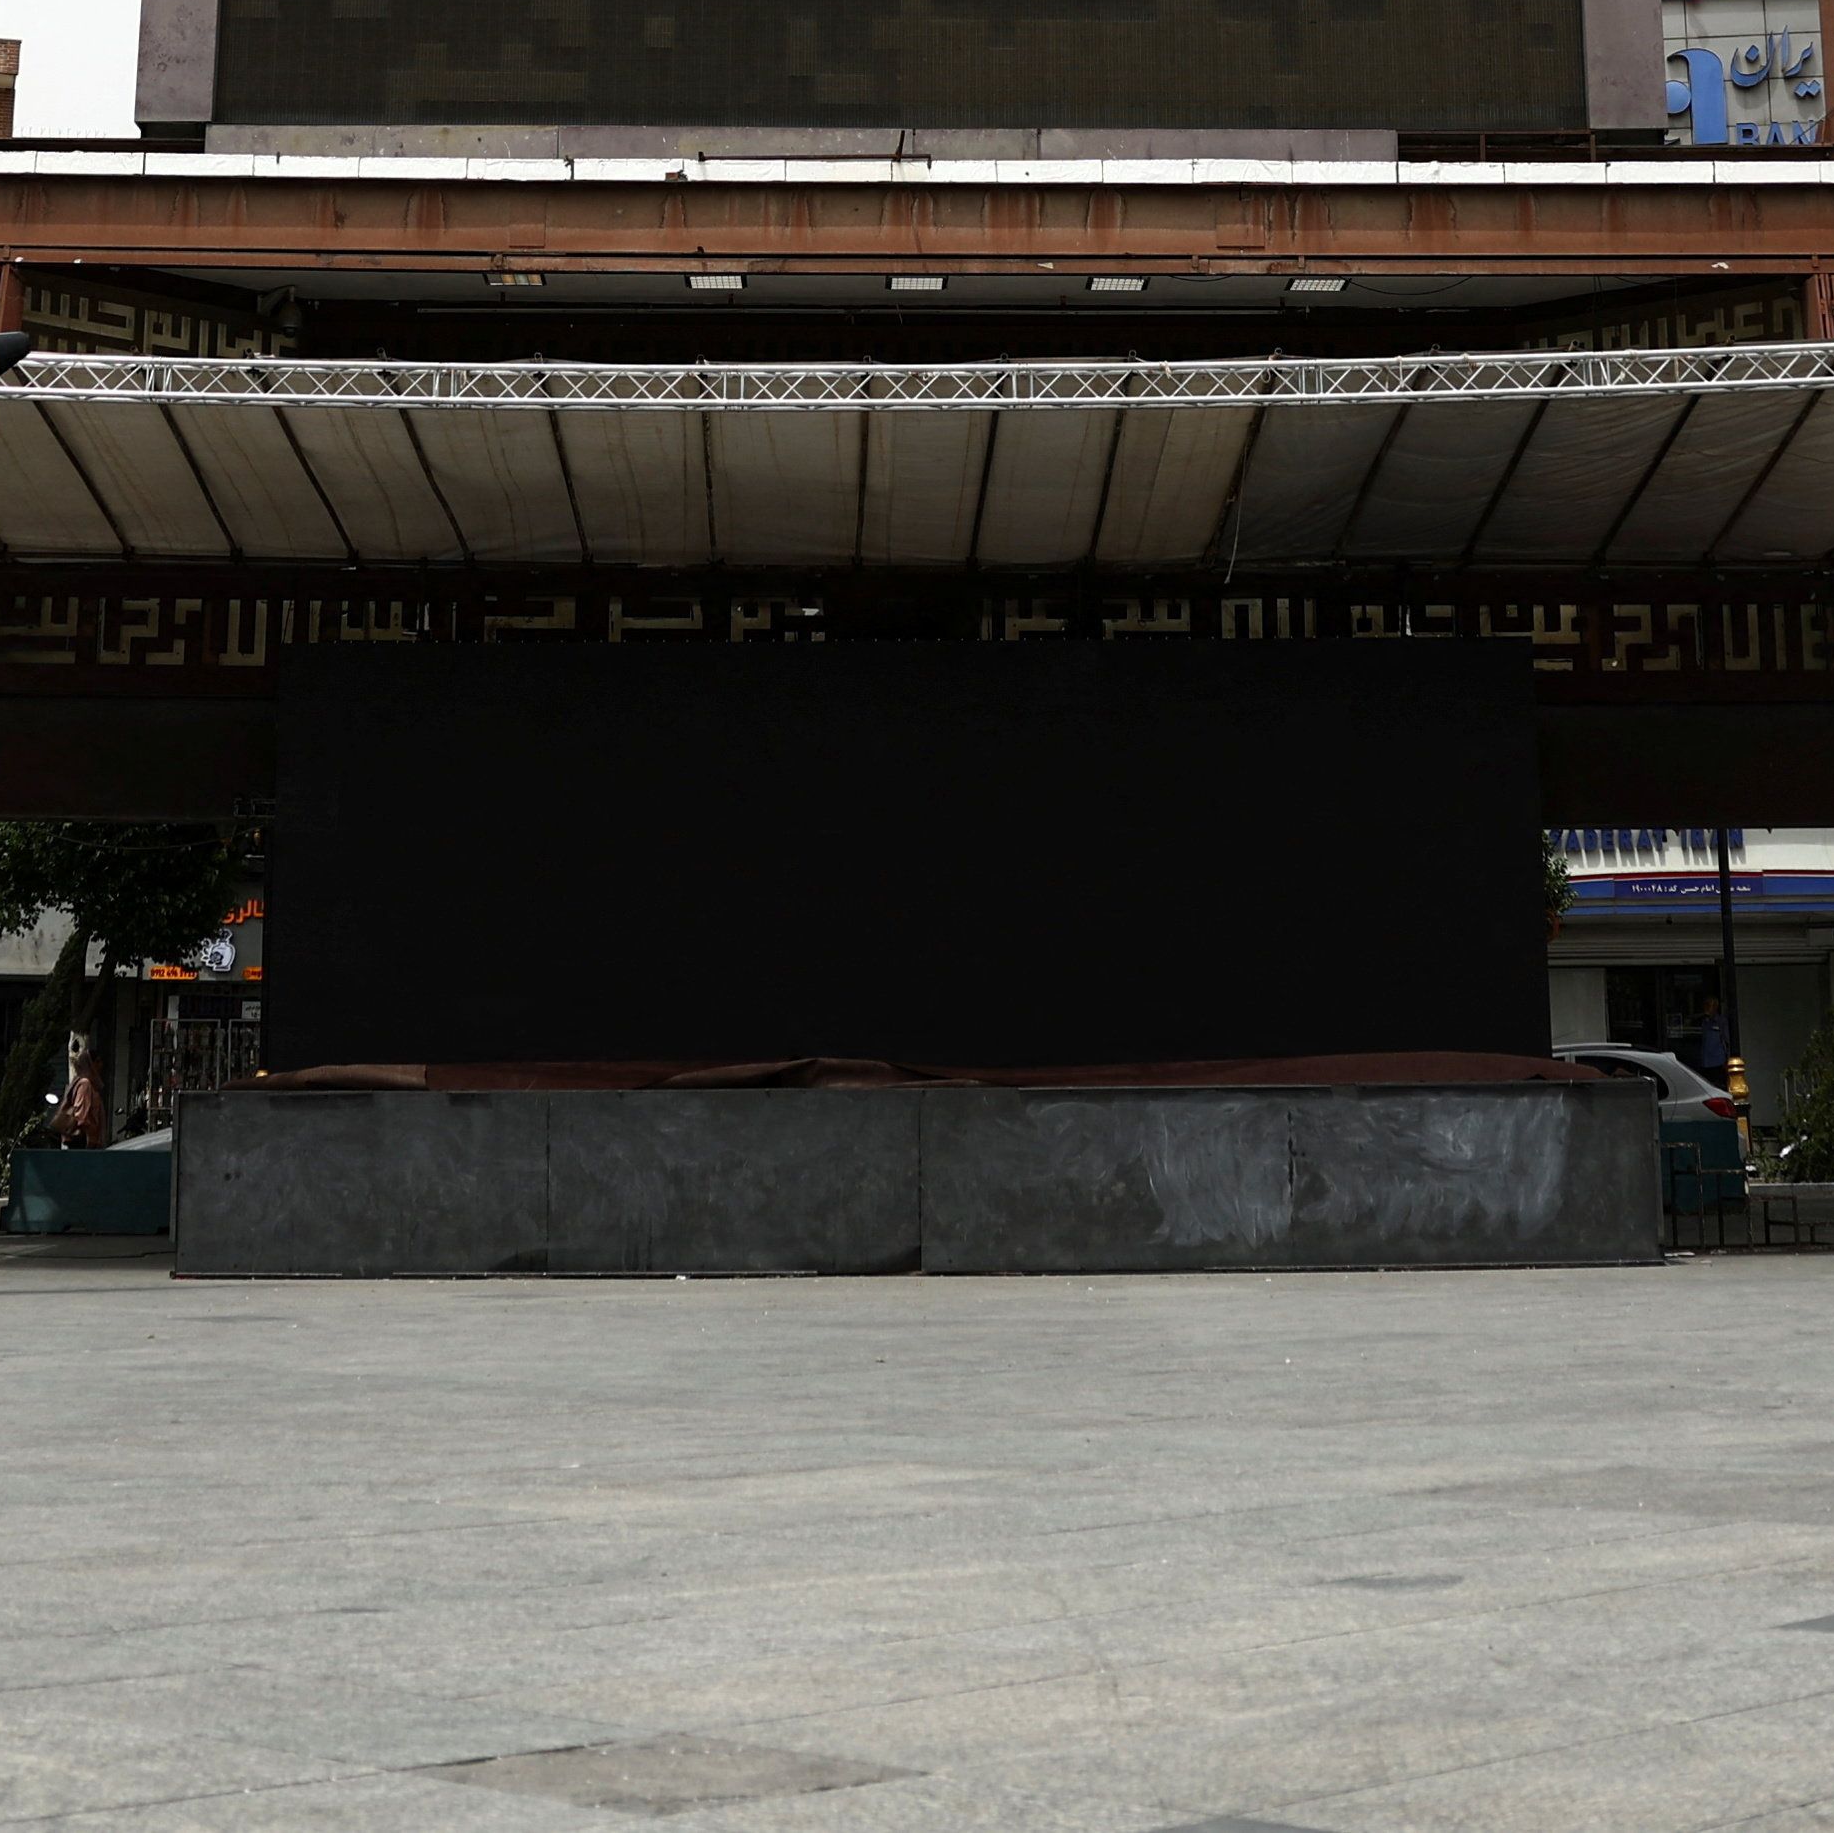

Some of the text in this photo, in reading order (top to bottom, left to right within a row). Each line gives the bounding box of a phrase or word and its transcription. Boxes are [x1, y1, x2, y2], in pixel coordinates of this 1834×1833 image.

[1730, 24, 1822, 100] یران
[1735, 119, 1819, 146] BAN
[220, 897, 265, 925] الری
